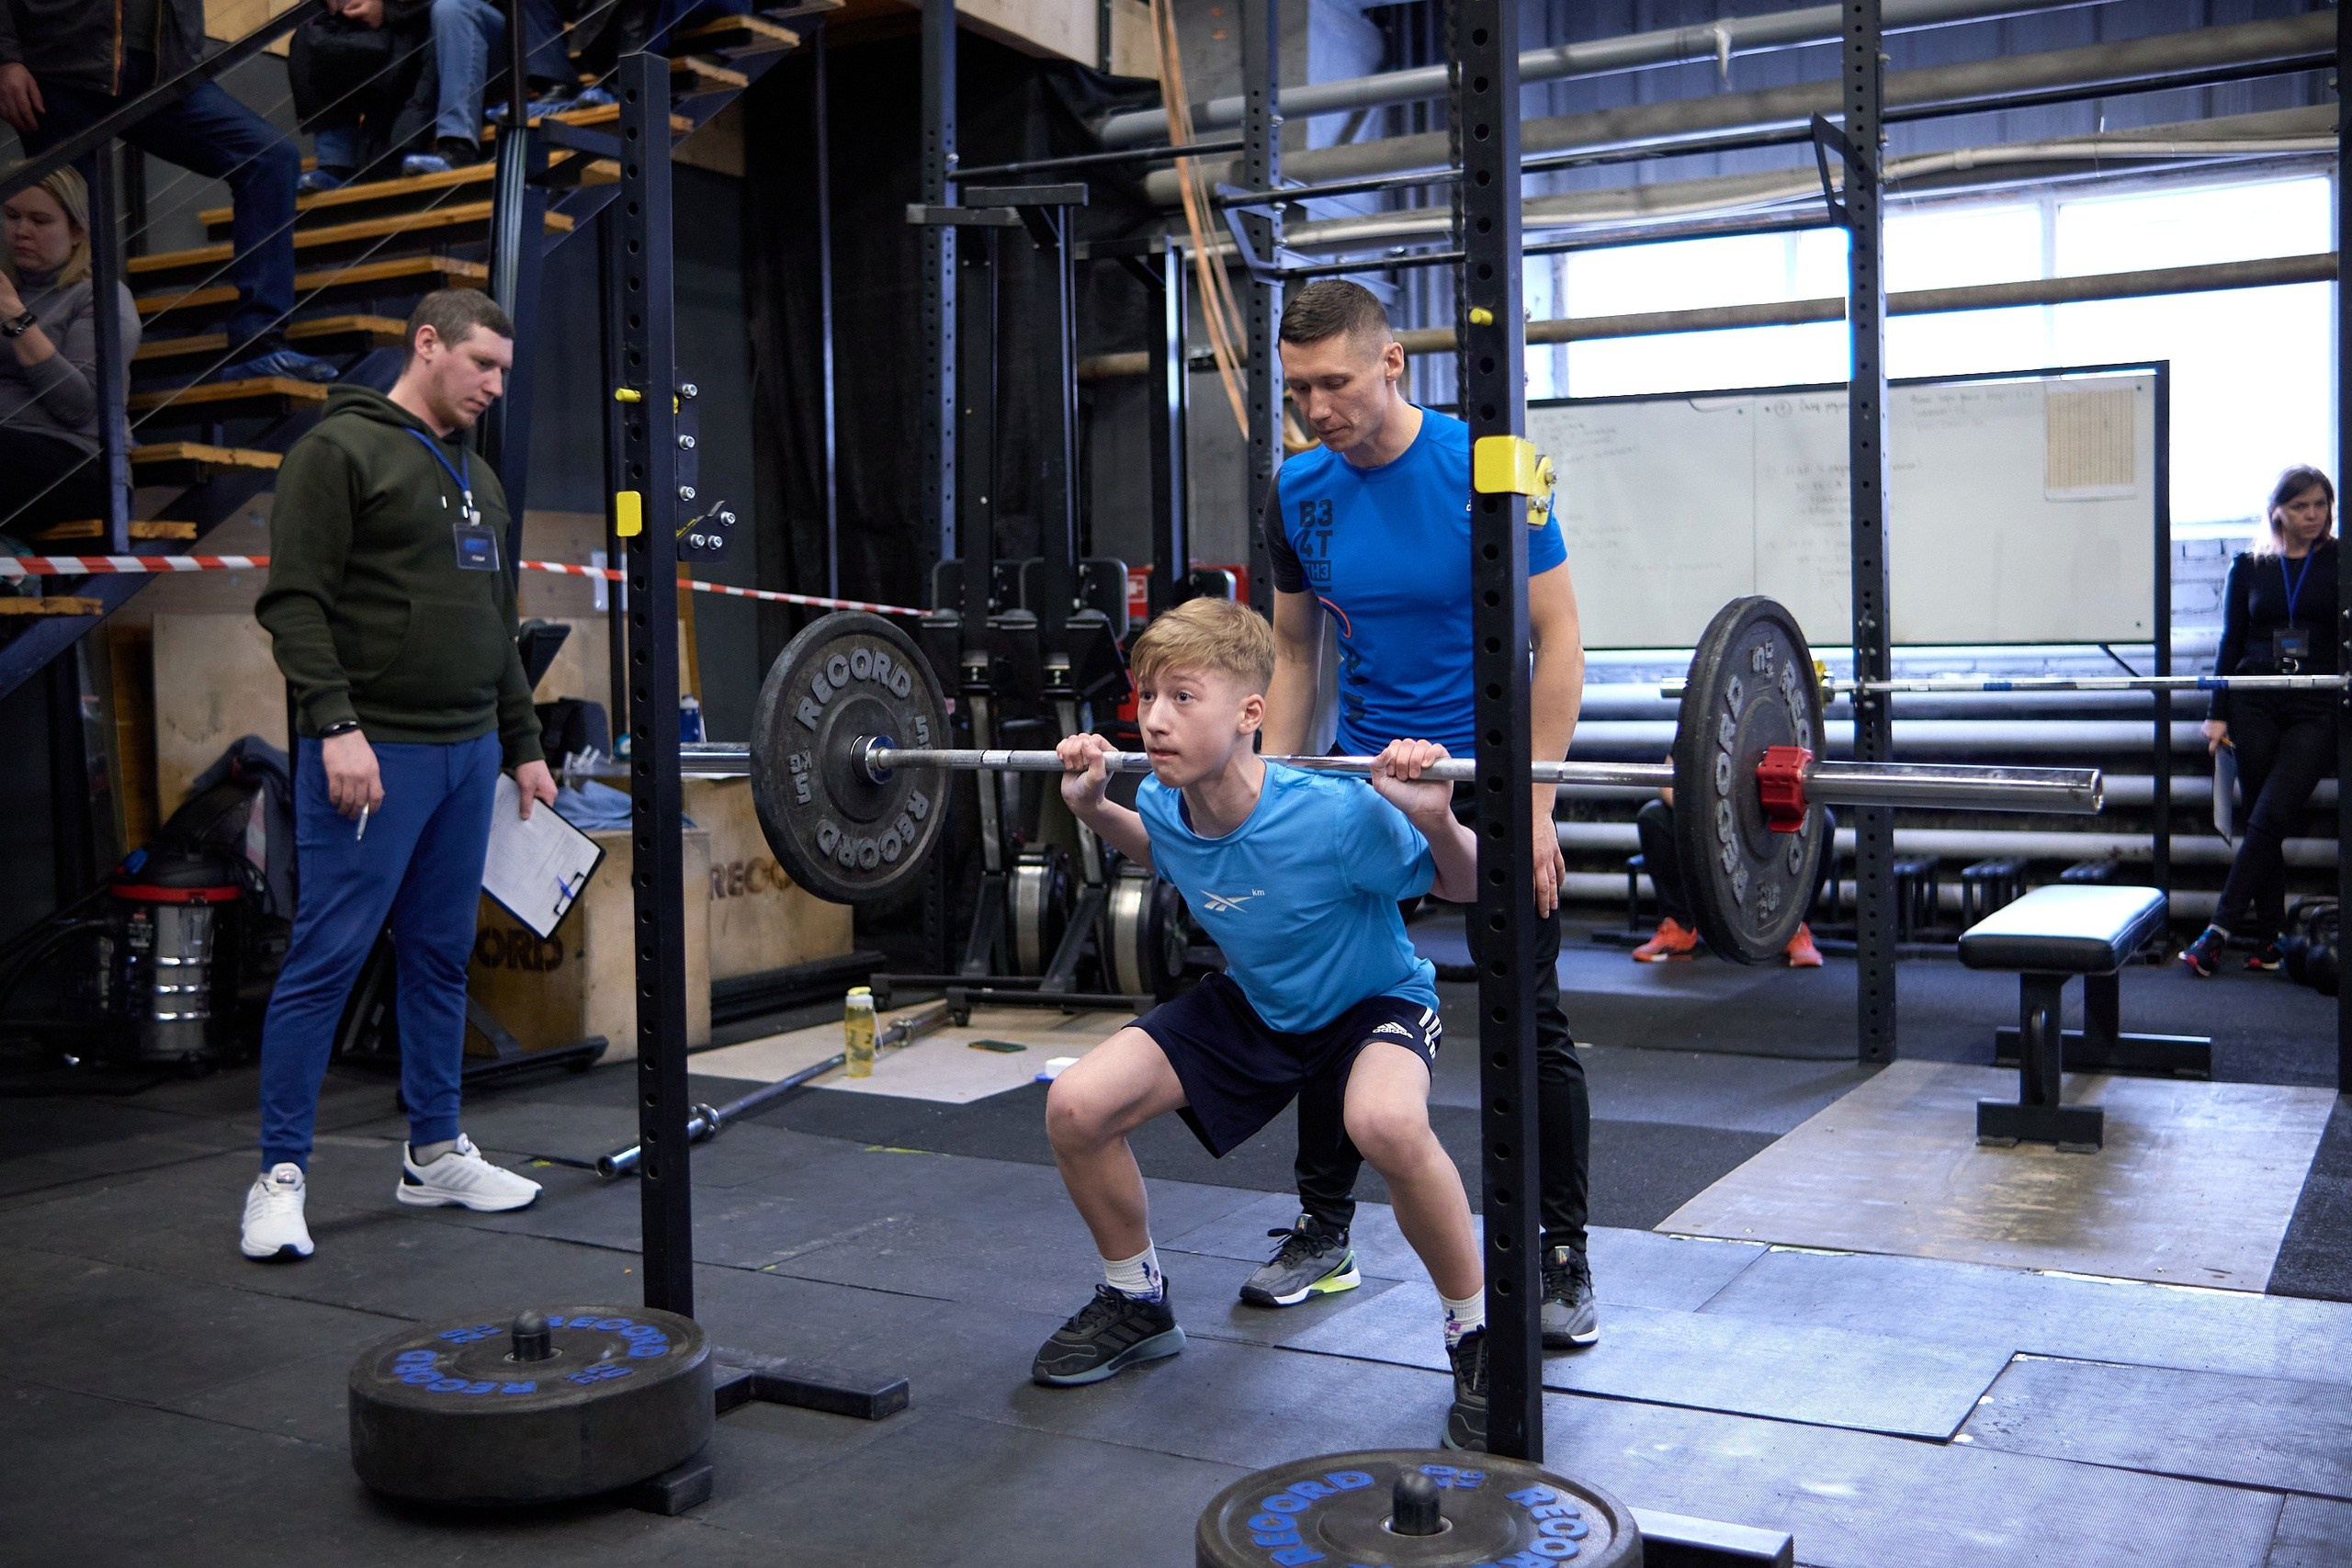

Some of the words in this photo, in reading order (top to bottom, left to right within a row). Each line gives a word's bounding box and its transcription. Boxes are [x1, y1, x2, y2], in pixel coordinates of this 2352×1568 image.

[1299, 500, 1332, 528] B3
[1300, 529, 1333, 558] 4T
[796, 648, 911, 730] RECORD
[915, 716, 930, 743] 5
[788, 750, 812, 773] KG
[1780, 657, 1811, 874] RECD
[795, 773, 812, 804] 5
[1715, 674, 1748, 906] RECORD
[816, 787, 929, 870] RECORD
[710, 857, 794, 900] RECO
[1251, 888, 1265, 897] km
[1373, 1027, 1413, 1038] adidas
[393, 1349, 537, 1395] RECORD
[1247, 1471, 1374, 1567] RECORD
[1472, 1485, 1589, 1568] RECOR
